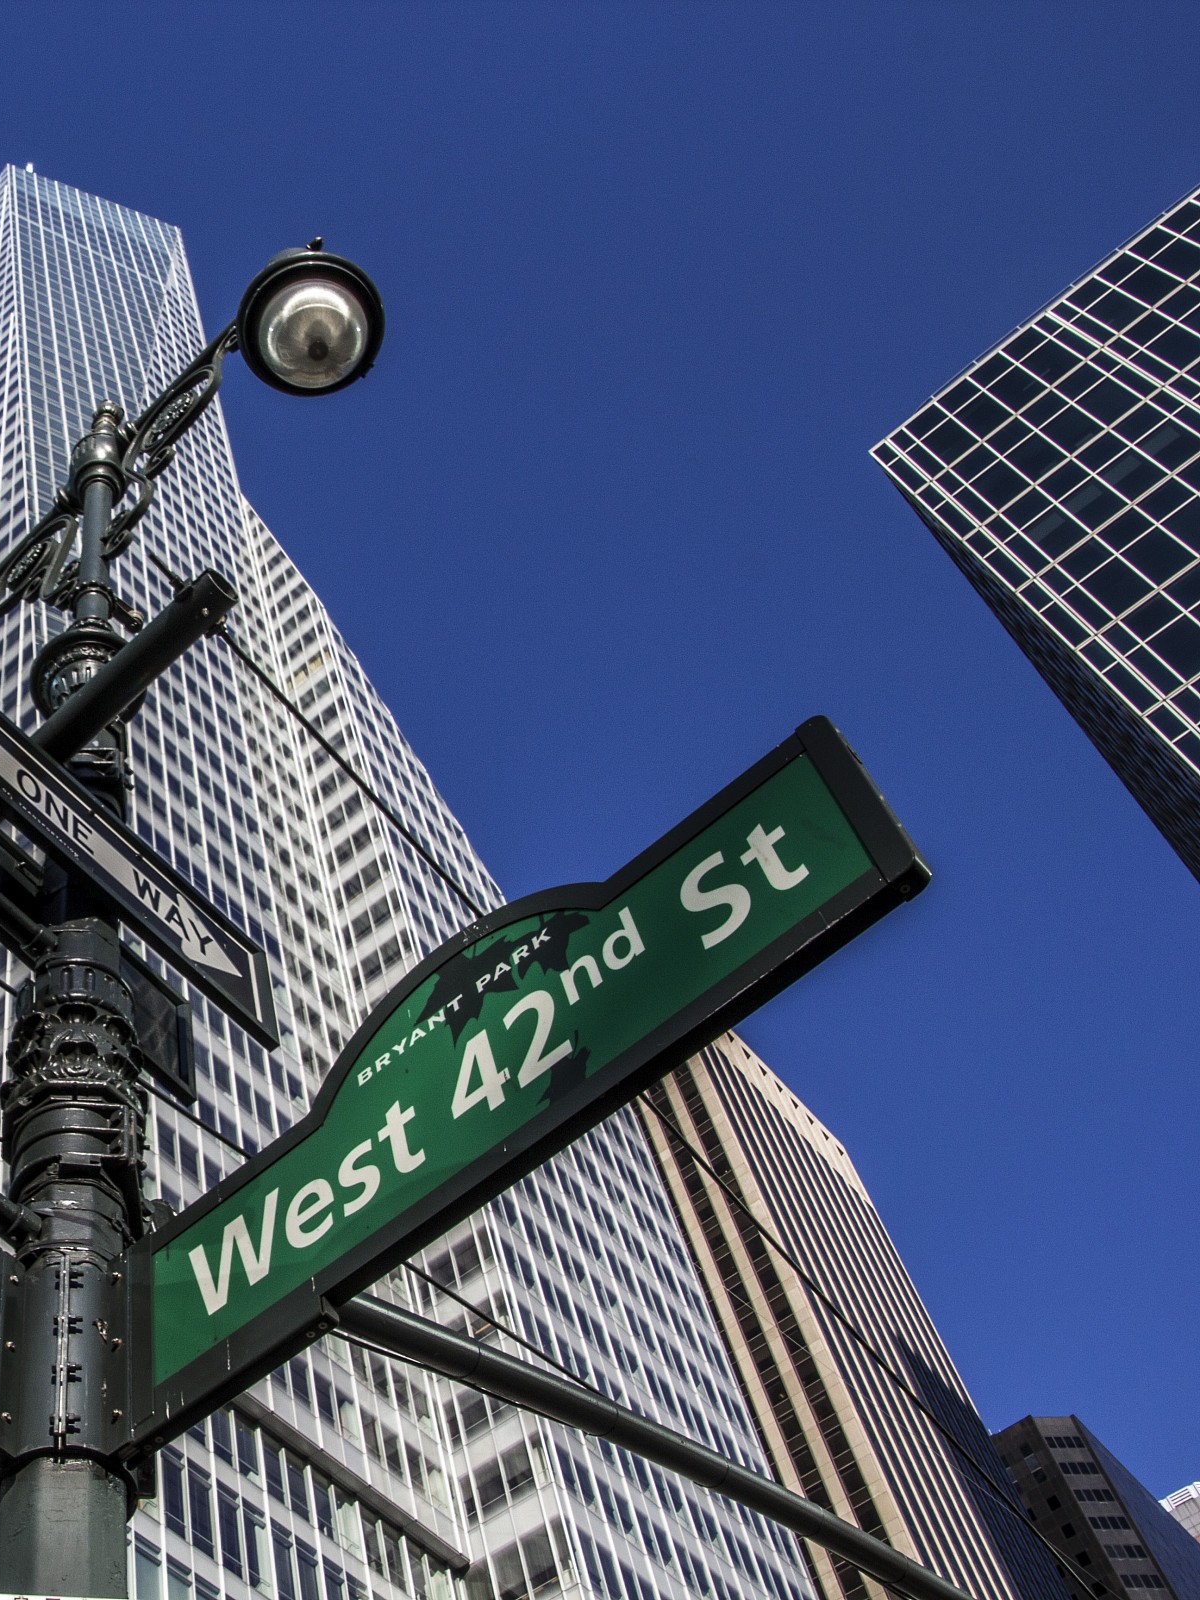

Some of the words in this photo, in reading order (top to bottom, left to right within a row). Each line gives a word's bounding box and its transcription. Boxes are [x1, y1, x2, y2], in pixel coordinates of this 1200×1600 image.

[16, 768, 94, 856] ONE
[132, 868, 214, 957] WAY
[188, 1100, 427, 1317] West
[451, 906, 646, 1120] 42nd
[680, 823, 810, 950] St
[356, 993, 463, 1087] BRYANT
[475, 927, 552, 993] PARK
